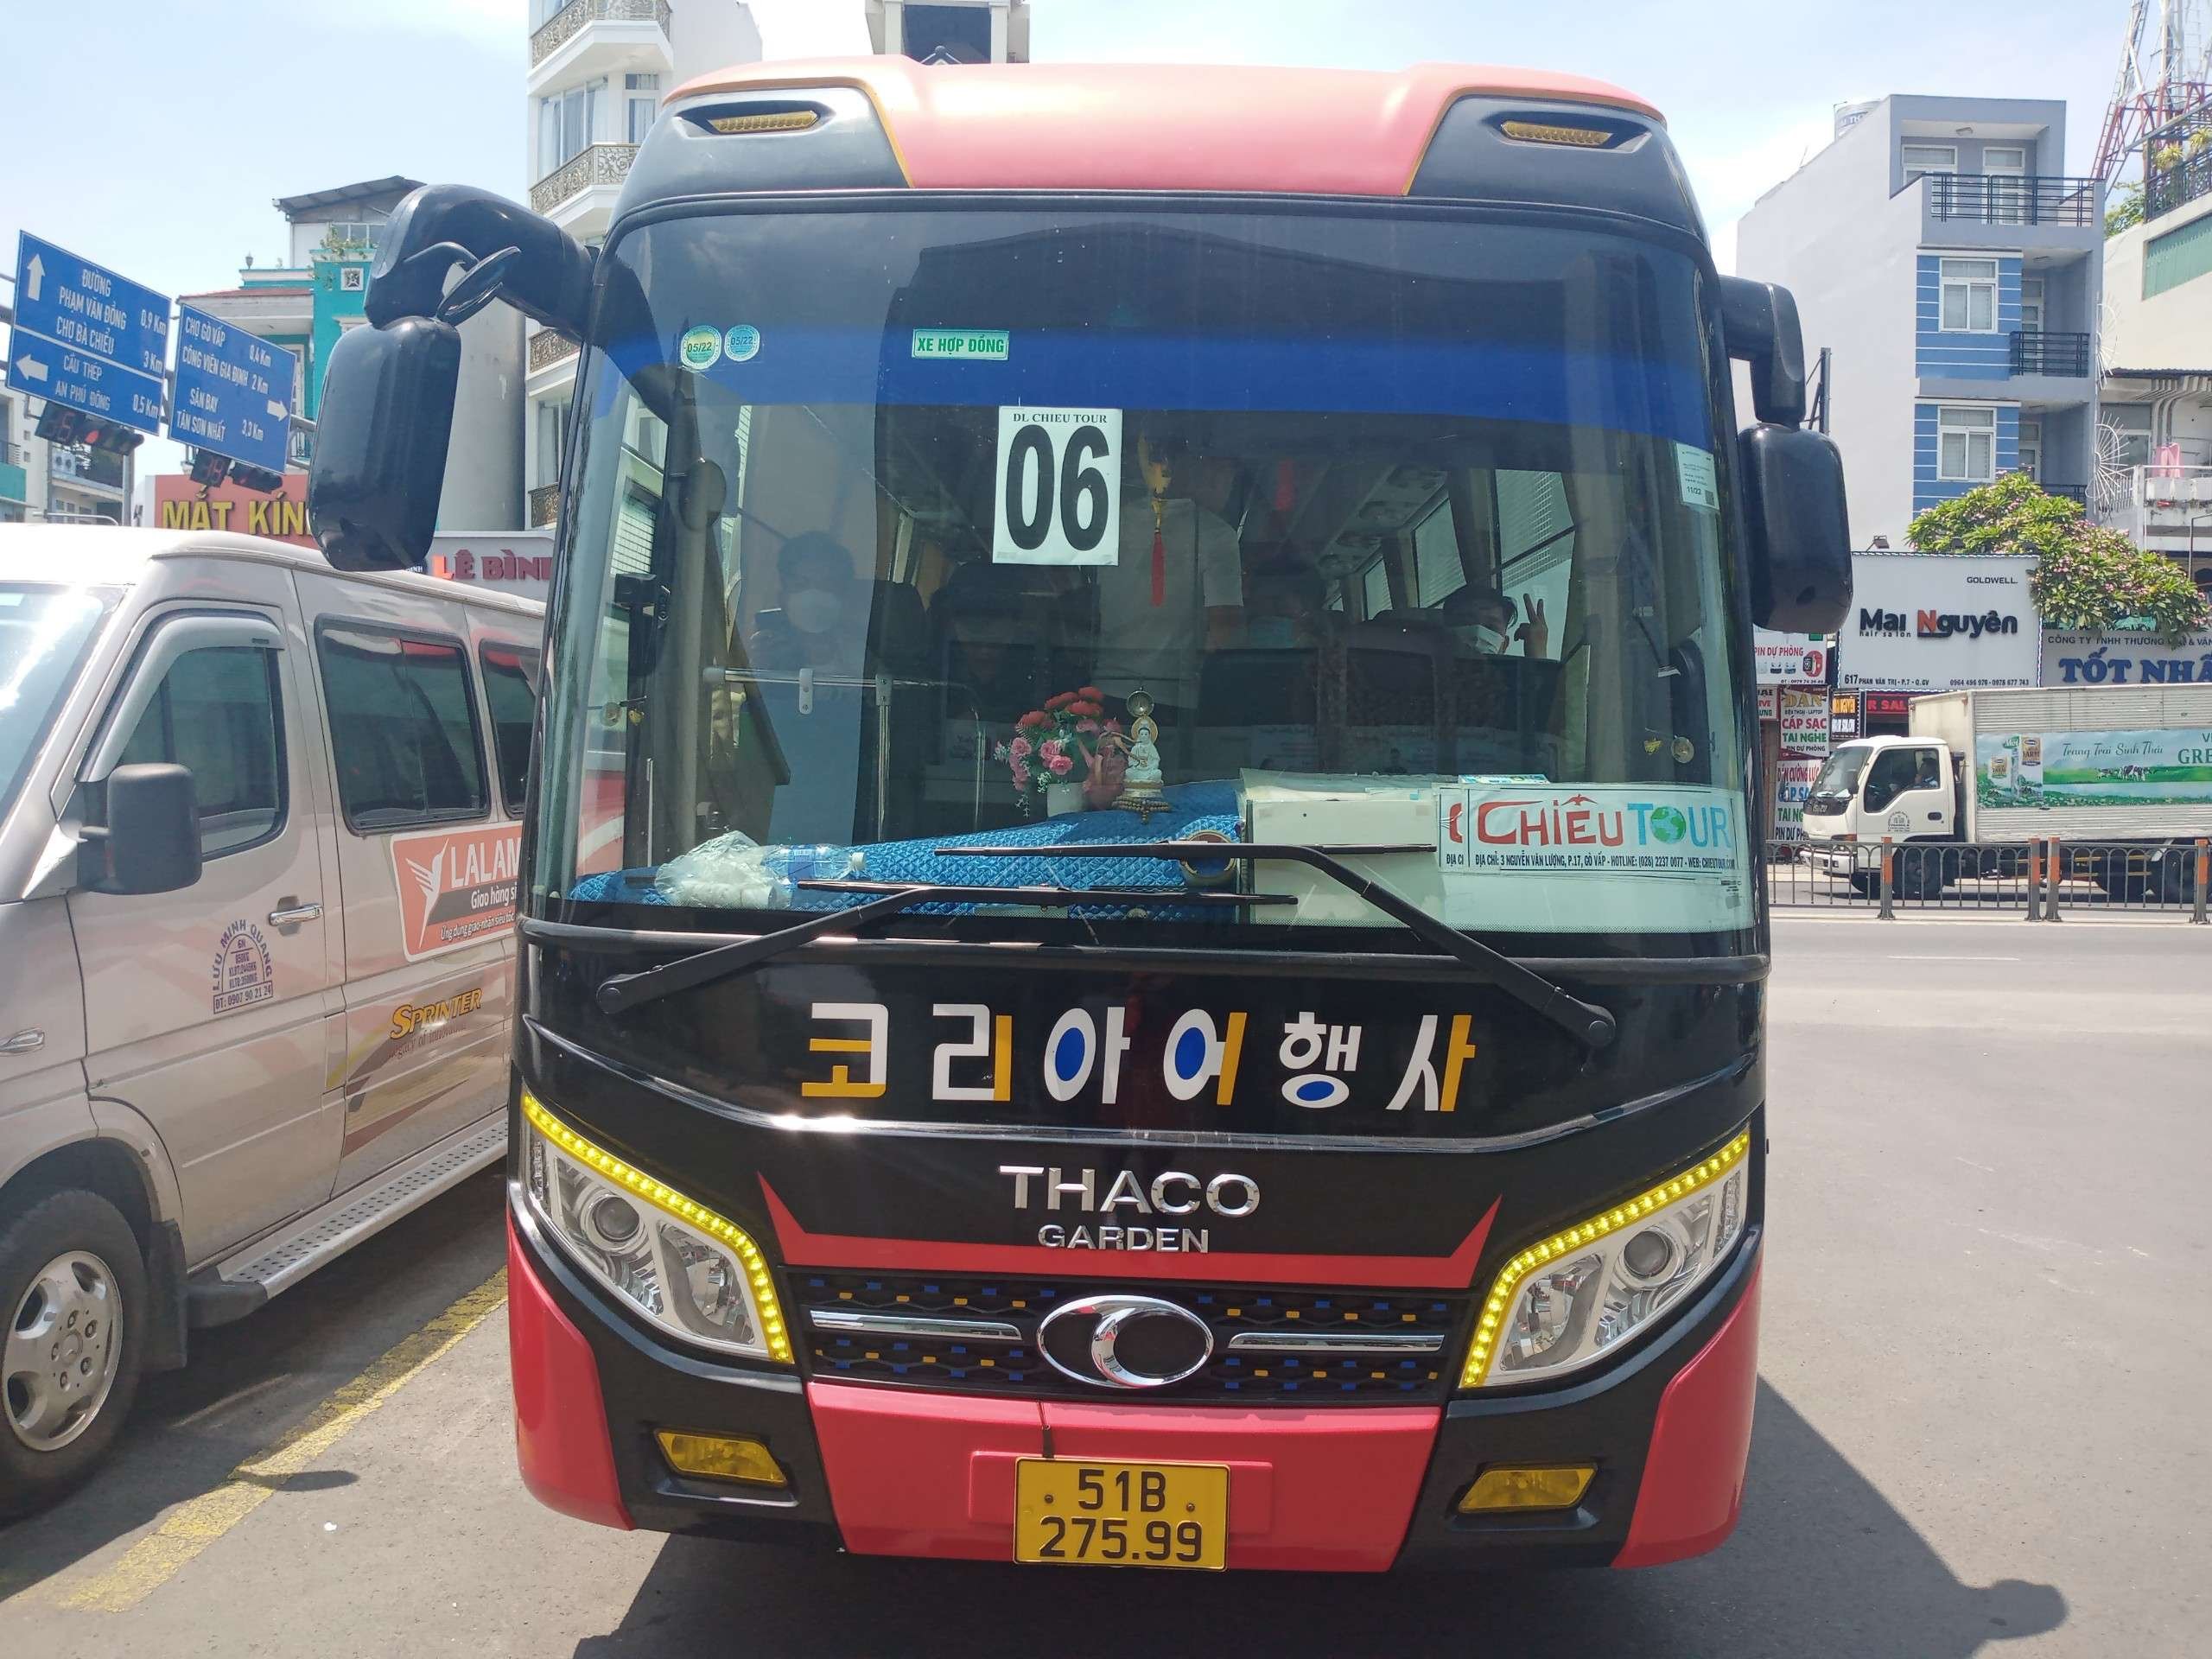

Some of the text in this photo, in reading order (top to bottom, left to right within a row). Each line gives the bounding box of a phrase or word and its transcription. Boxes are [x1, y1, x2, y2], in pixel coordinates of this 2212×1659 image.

[82, 269, 111, 296] ĐƯỜNG
[59, 286, 85, 313] PHẠM
[86, 296, 103, 321] VĂN
[56, 316, 74, 342] CHỢ
[76, 322, 87, 345] BÀ
[153, 314, 167, 336] Km
[687, 341, 712, 353] 05/22
[730, 336, 753, 346] 05/22
[918, 337, 934, 352] XE
[938, 336, 964, 354] HỢP
[83, 361, 102, 381] THÉP
[143, 351, 163, 373] 3 Km
[55, 380, 67, 397] AN
[69, 384, 86, 404] PHÚ
[251, 374, 269, 395] 2 Km
[145, 398, 159, 419] Km
[206, 393, 219, 413] BAY
[176, 410, 190, 430] TÂN
[1013, 413, 1108, 423] DL CHIEU TOUR
[252, 423, 264, 442] Km
[1005, 424, 1109, 551] 06
[433, 549, 475, 581] LÊ
[1916, 609, 2018, 639] Nguyên
[2048, 634, 2076, 644] CÔNG
[1779, 645, 1803, 657] PHÒNG
[2058, 646, 2133, 683] TỐT
[1844, 674, 1858, 684] 617
[1782, 715, 1803, 729] CÁP
[1806, 718, 1827, 732] SẠC
[1783, 733, 1827, 742] TAI NGHE
[2063, 743, 2090, 758] Trang
[2115, 742, 2139, 756] Sinh
[1627, 802, 1732, 849] TOUR
[1777, 808, 1791, 822] TAI
[1776, 827, 1785, 840] PIN
[1446, 854, 1457, 867] ĐỊA
[1475, 854, 1485, 868] ĐỊA
[1486, 850, 1499, 865] CHỈ:
[1500, 855, 1504, 865] 3
[1506, 849, 1529, 865] NGUYỄN
[1531, 853, 1544, 865] VĂN
[1567, 855, 1583, 868] P.17,
[1584, 852, 1592, 866] GÒ
[1593, 851, 1606, 866] VẤP
[1611, 855, 1637, 868] HOTLINE:
[1638, 855, 1654, 868] (028)
[1655, 856, 1669, 868] 2237
[1669, 856, 1683, 868] 0077
[1688, 857, 1701, 868] WEB:
[471, 889, 489, 909] Giao
[490, 885, 509, 906] hàng
[441, 924, 453, 940] Ứng
[453, 923, 467, 938] dụng
[220, 919, 247, 949] MINH
[250, 924, 272, 978] QUANG
[227, 992, 243, 1006] 0907
[245, 989, 253, 1001] 90
[254, 988, 262, 999] 21
[264, 984, 271, 996] 24
[390, 988, 484, 1039] SPRINTER
[999, 1165, 1260, 1218] THACO
[1038, 1223, 1210, 1254] GARDEN
[1077, 1468, 1166, 1512] 51B
[1039, 1516, 1203, 1562] 275.99
